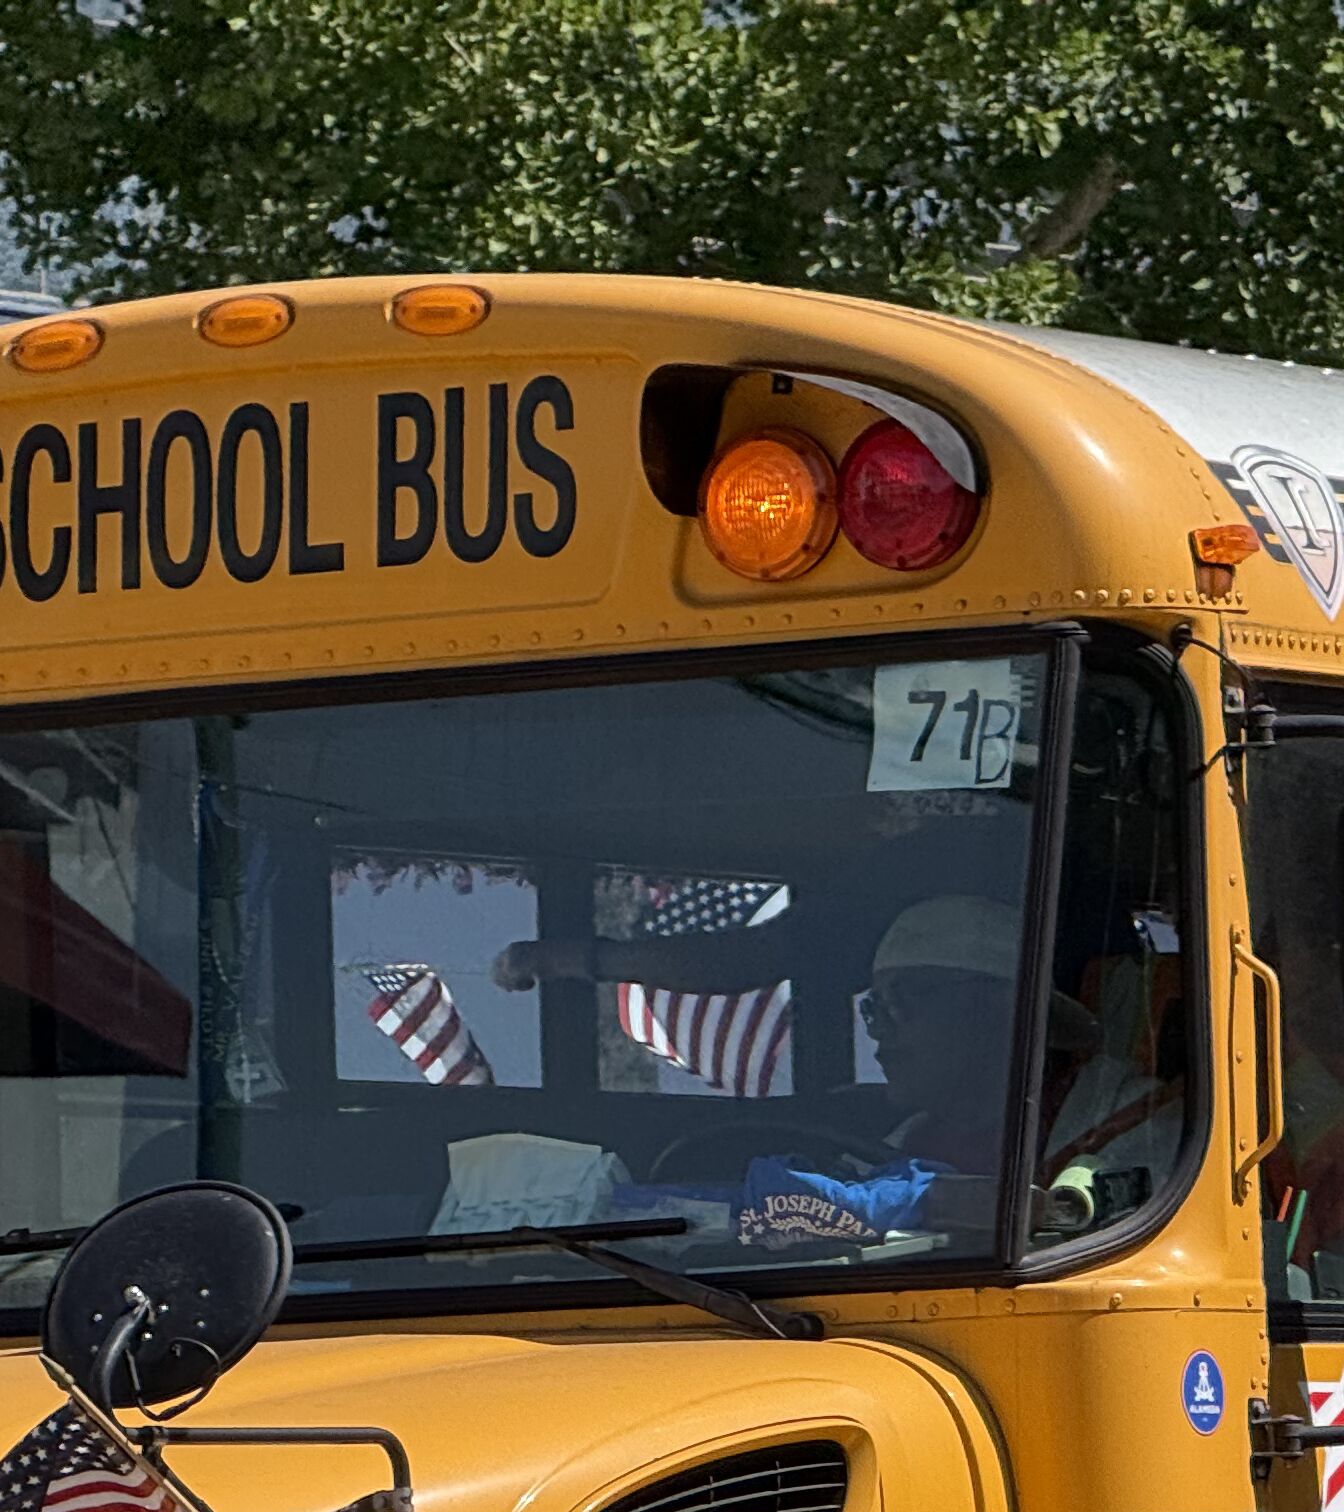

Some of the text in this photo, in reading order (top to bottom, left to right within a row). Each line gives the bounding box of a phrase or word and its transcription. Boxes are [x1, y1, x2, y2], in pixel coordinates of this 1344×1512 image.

[376, 375, 577, 568] BUS
[908, 688, 1016, 785] 71B
[764, 1194, 837, 1222] JOSEPH
